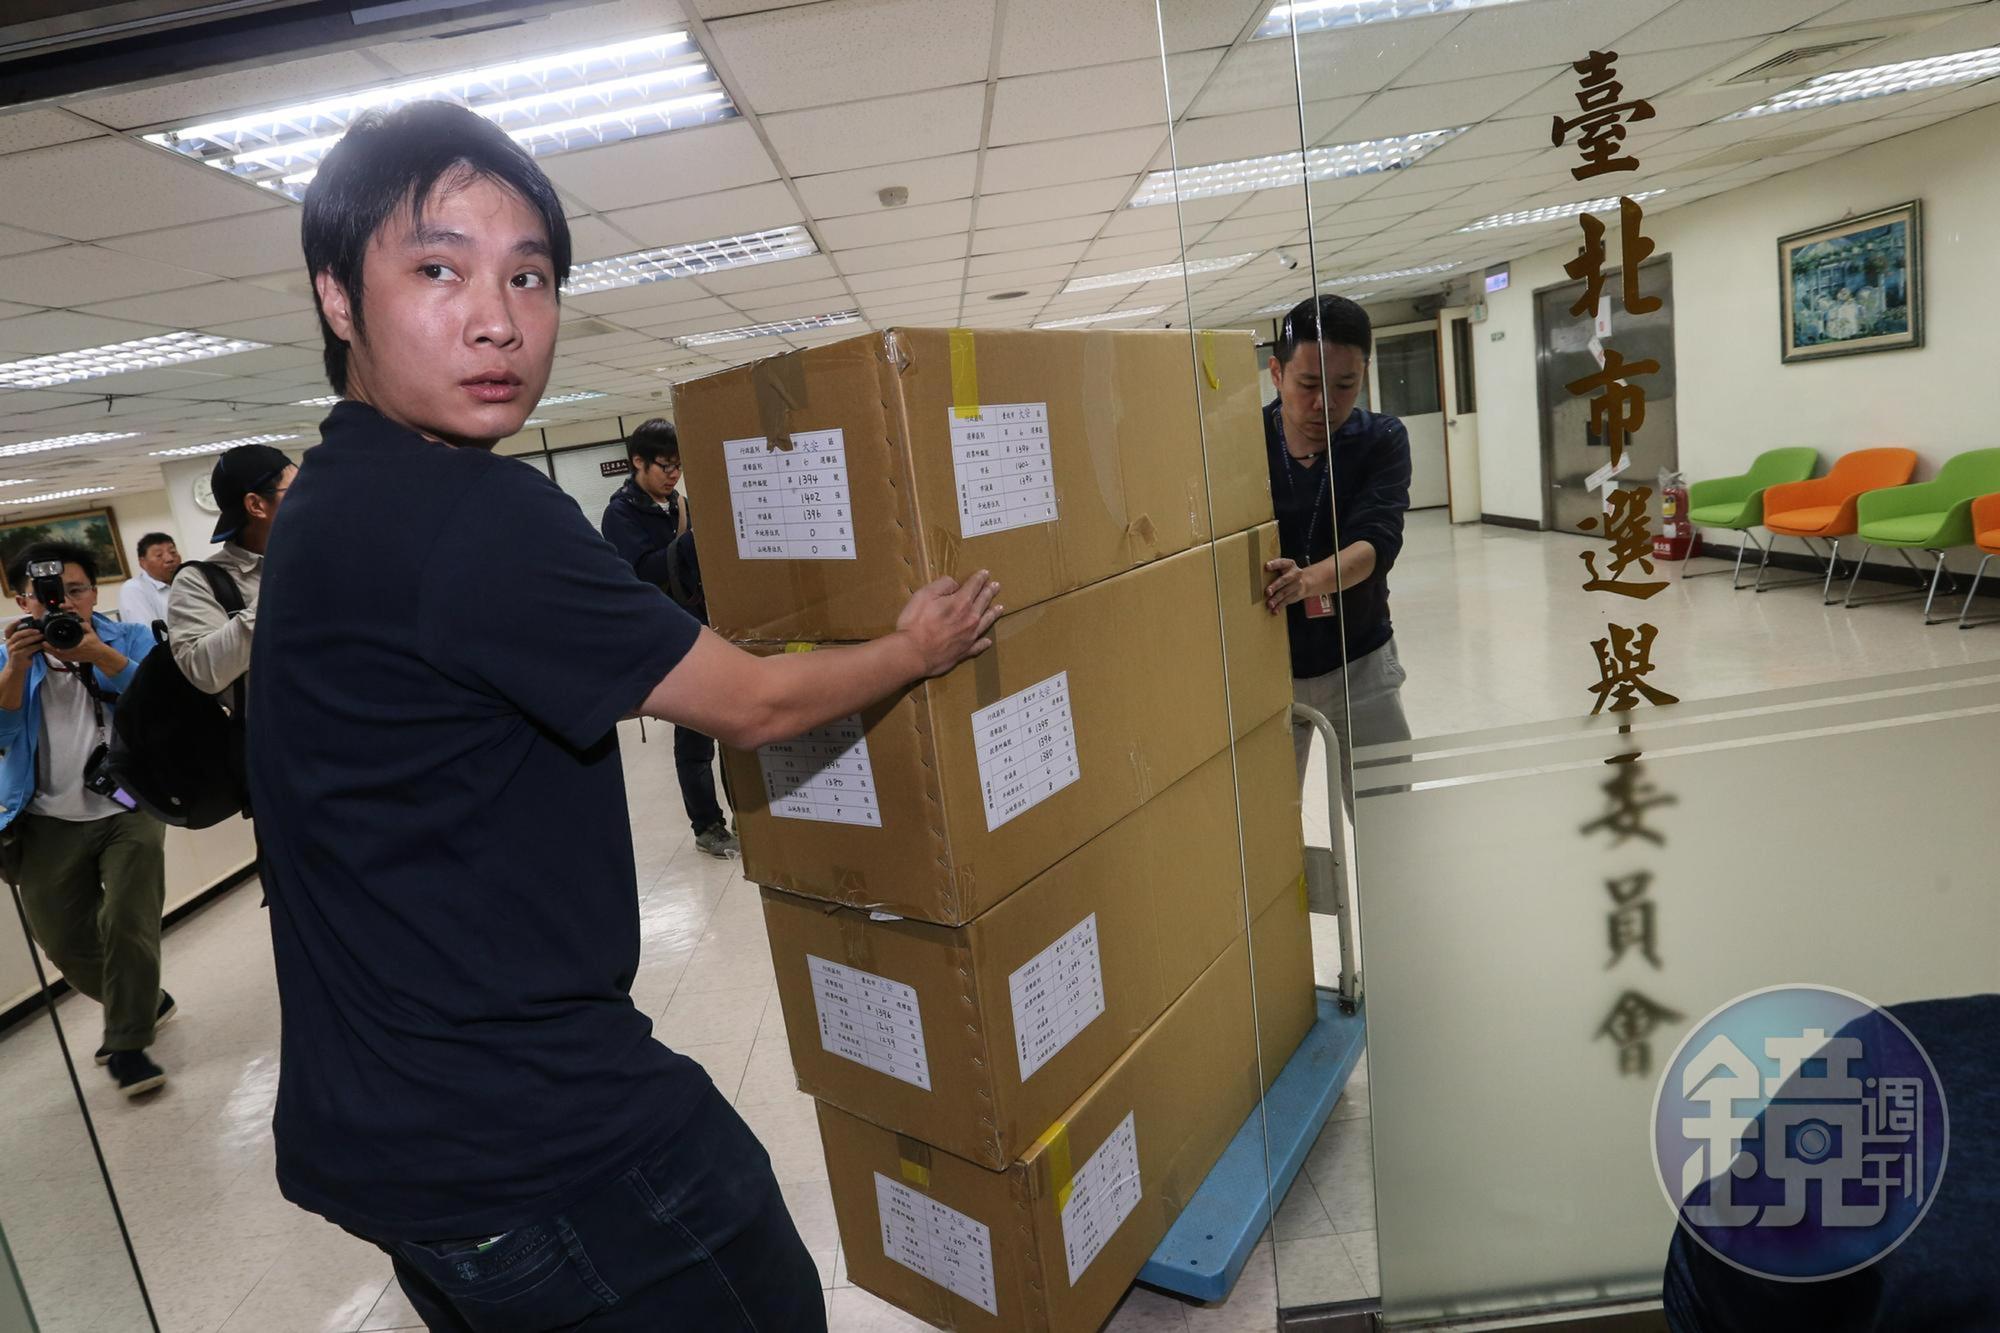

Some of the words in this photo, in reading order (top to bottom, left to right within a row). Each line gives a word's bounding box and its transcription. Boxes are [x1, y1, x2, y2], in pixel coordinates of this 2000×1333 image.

[803, 441, 819, 453] 大安
[799, 474, 818, 486] 1394
[802, 492, 821, 504] 1402
[804, 510, 822, 520] 1396
[1552, 50, 1688, 1078] 臺北市選舉委員會
[1036, 719, 1049, 733] 1395
[1039, 735, 1052, 748] 1396
[876, 1009, 892, 1019] 1396
